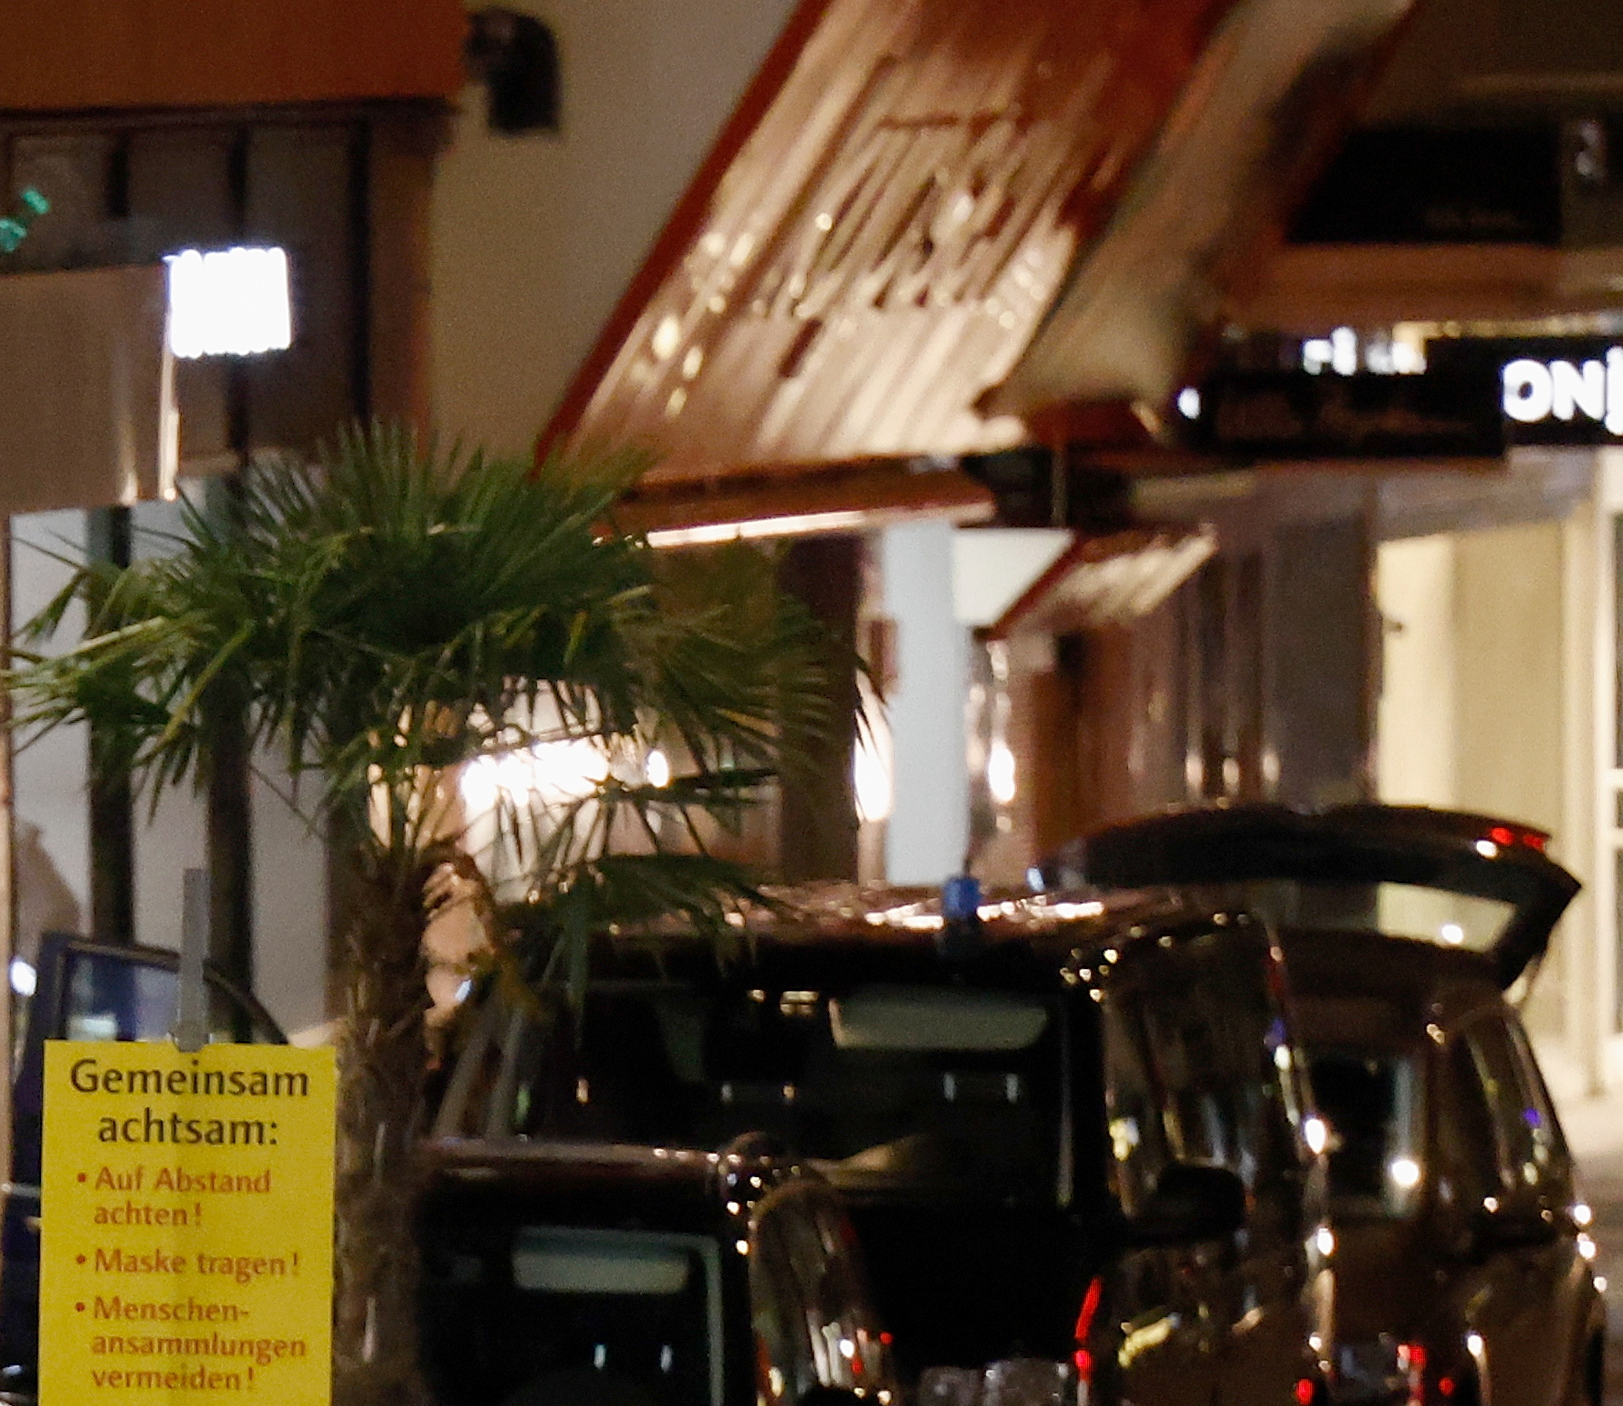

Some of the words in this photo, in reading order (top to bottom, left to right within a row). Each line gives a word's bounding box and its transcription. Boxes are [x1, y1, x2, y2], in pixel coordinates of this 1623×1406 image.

[70, 1057, 309, 1097] Gemeinsam
[97, 1106, 278, 1145] achtsam:
[95, 1165, 144, 1191] Auf
[155, 1167, 271, 1193] Abstand
[95, 1248, 186, 1274] Maske
[93, 1296, 250, 1322] Menschen-
[91, 1332, 307, 1367] ansammlungen
